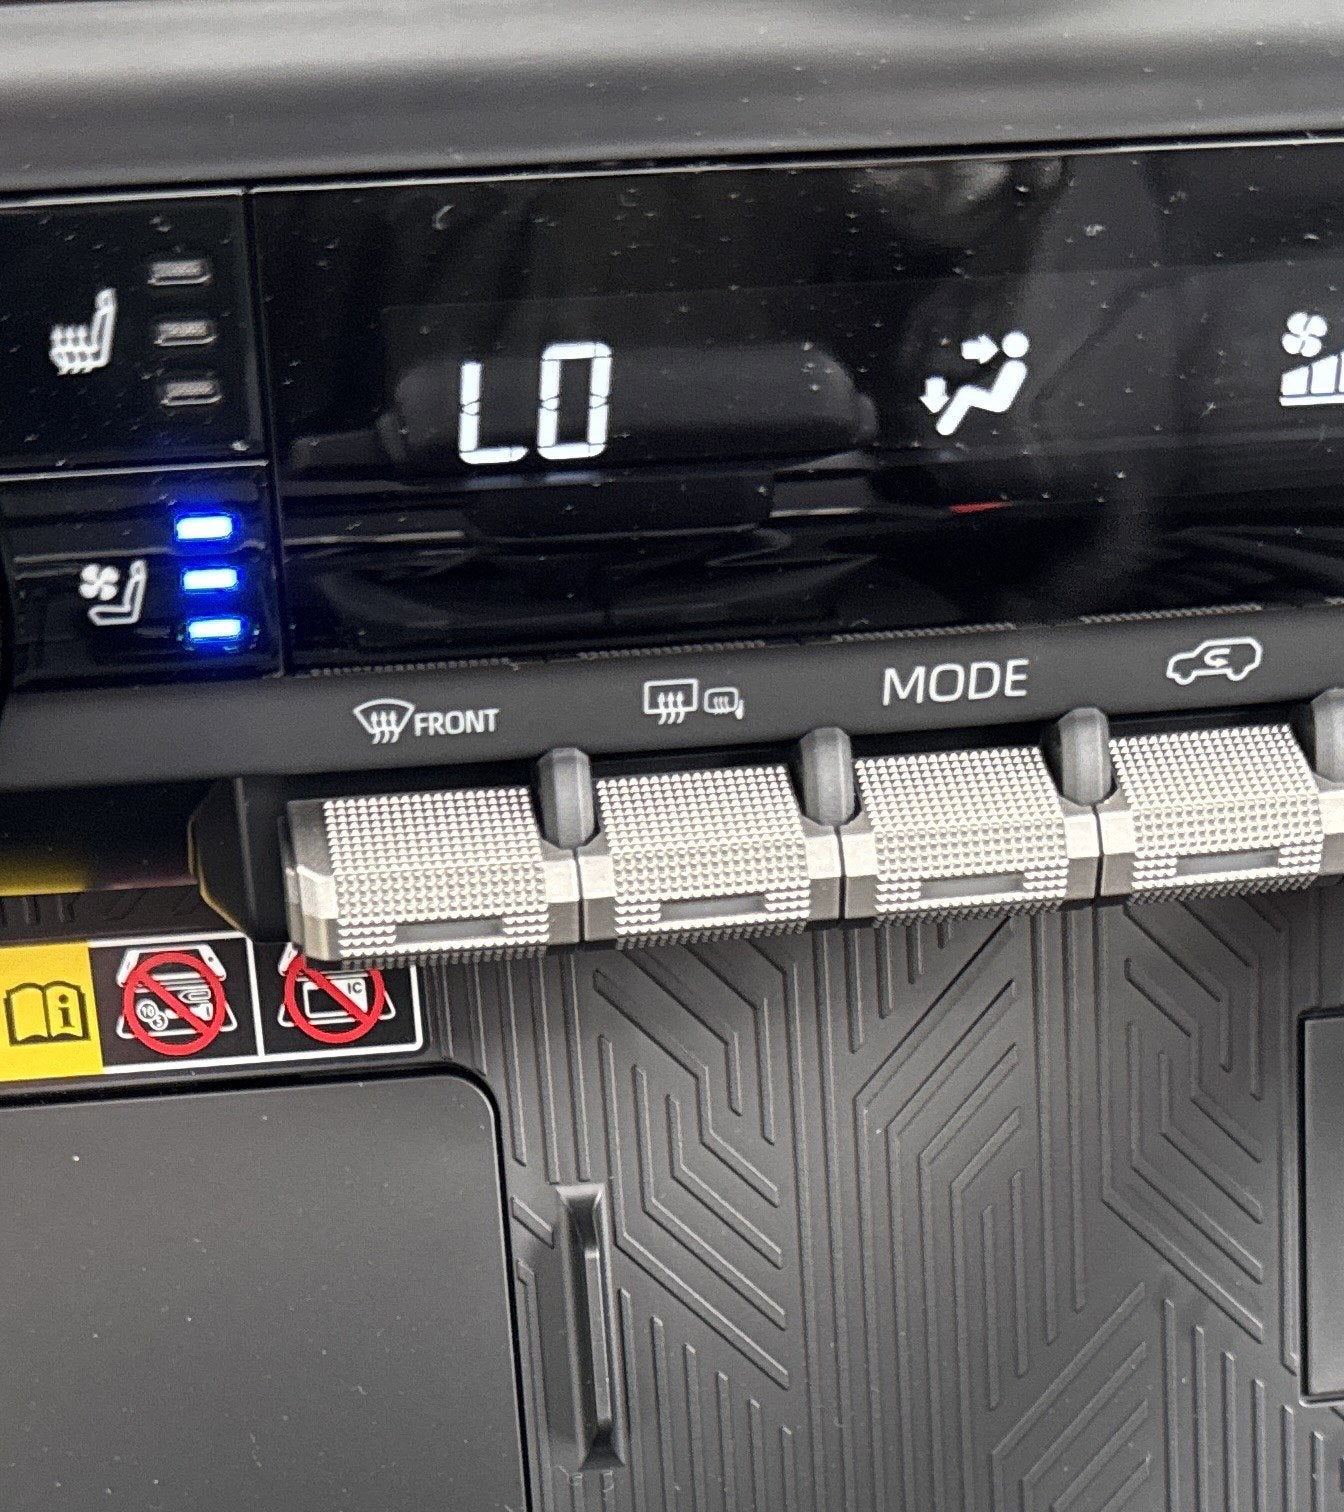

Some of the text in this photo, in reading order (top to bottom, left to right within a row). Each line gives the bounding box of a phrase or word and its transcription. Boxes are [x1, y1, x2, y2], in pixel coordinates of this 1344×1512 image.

[882, 657, 1030, 706] MODE
[414, 708, 500, 737] FRONT
[347, 981, 362, 994] IC
